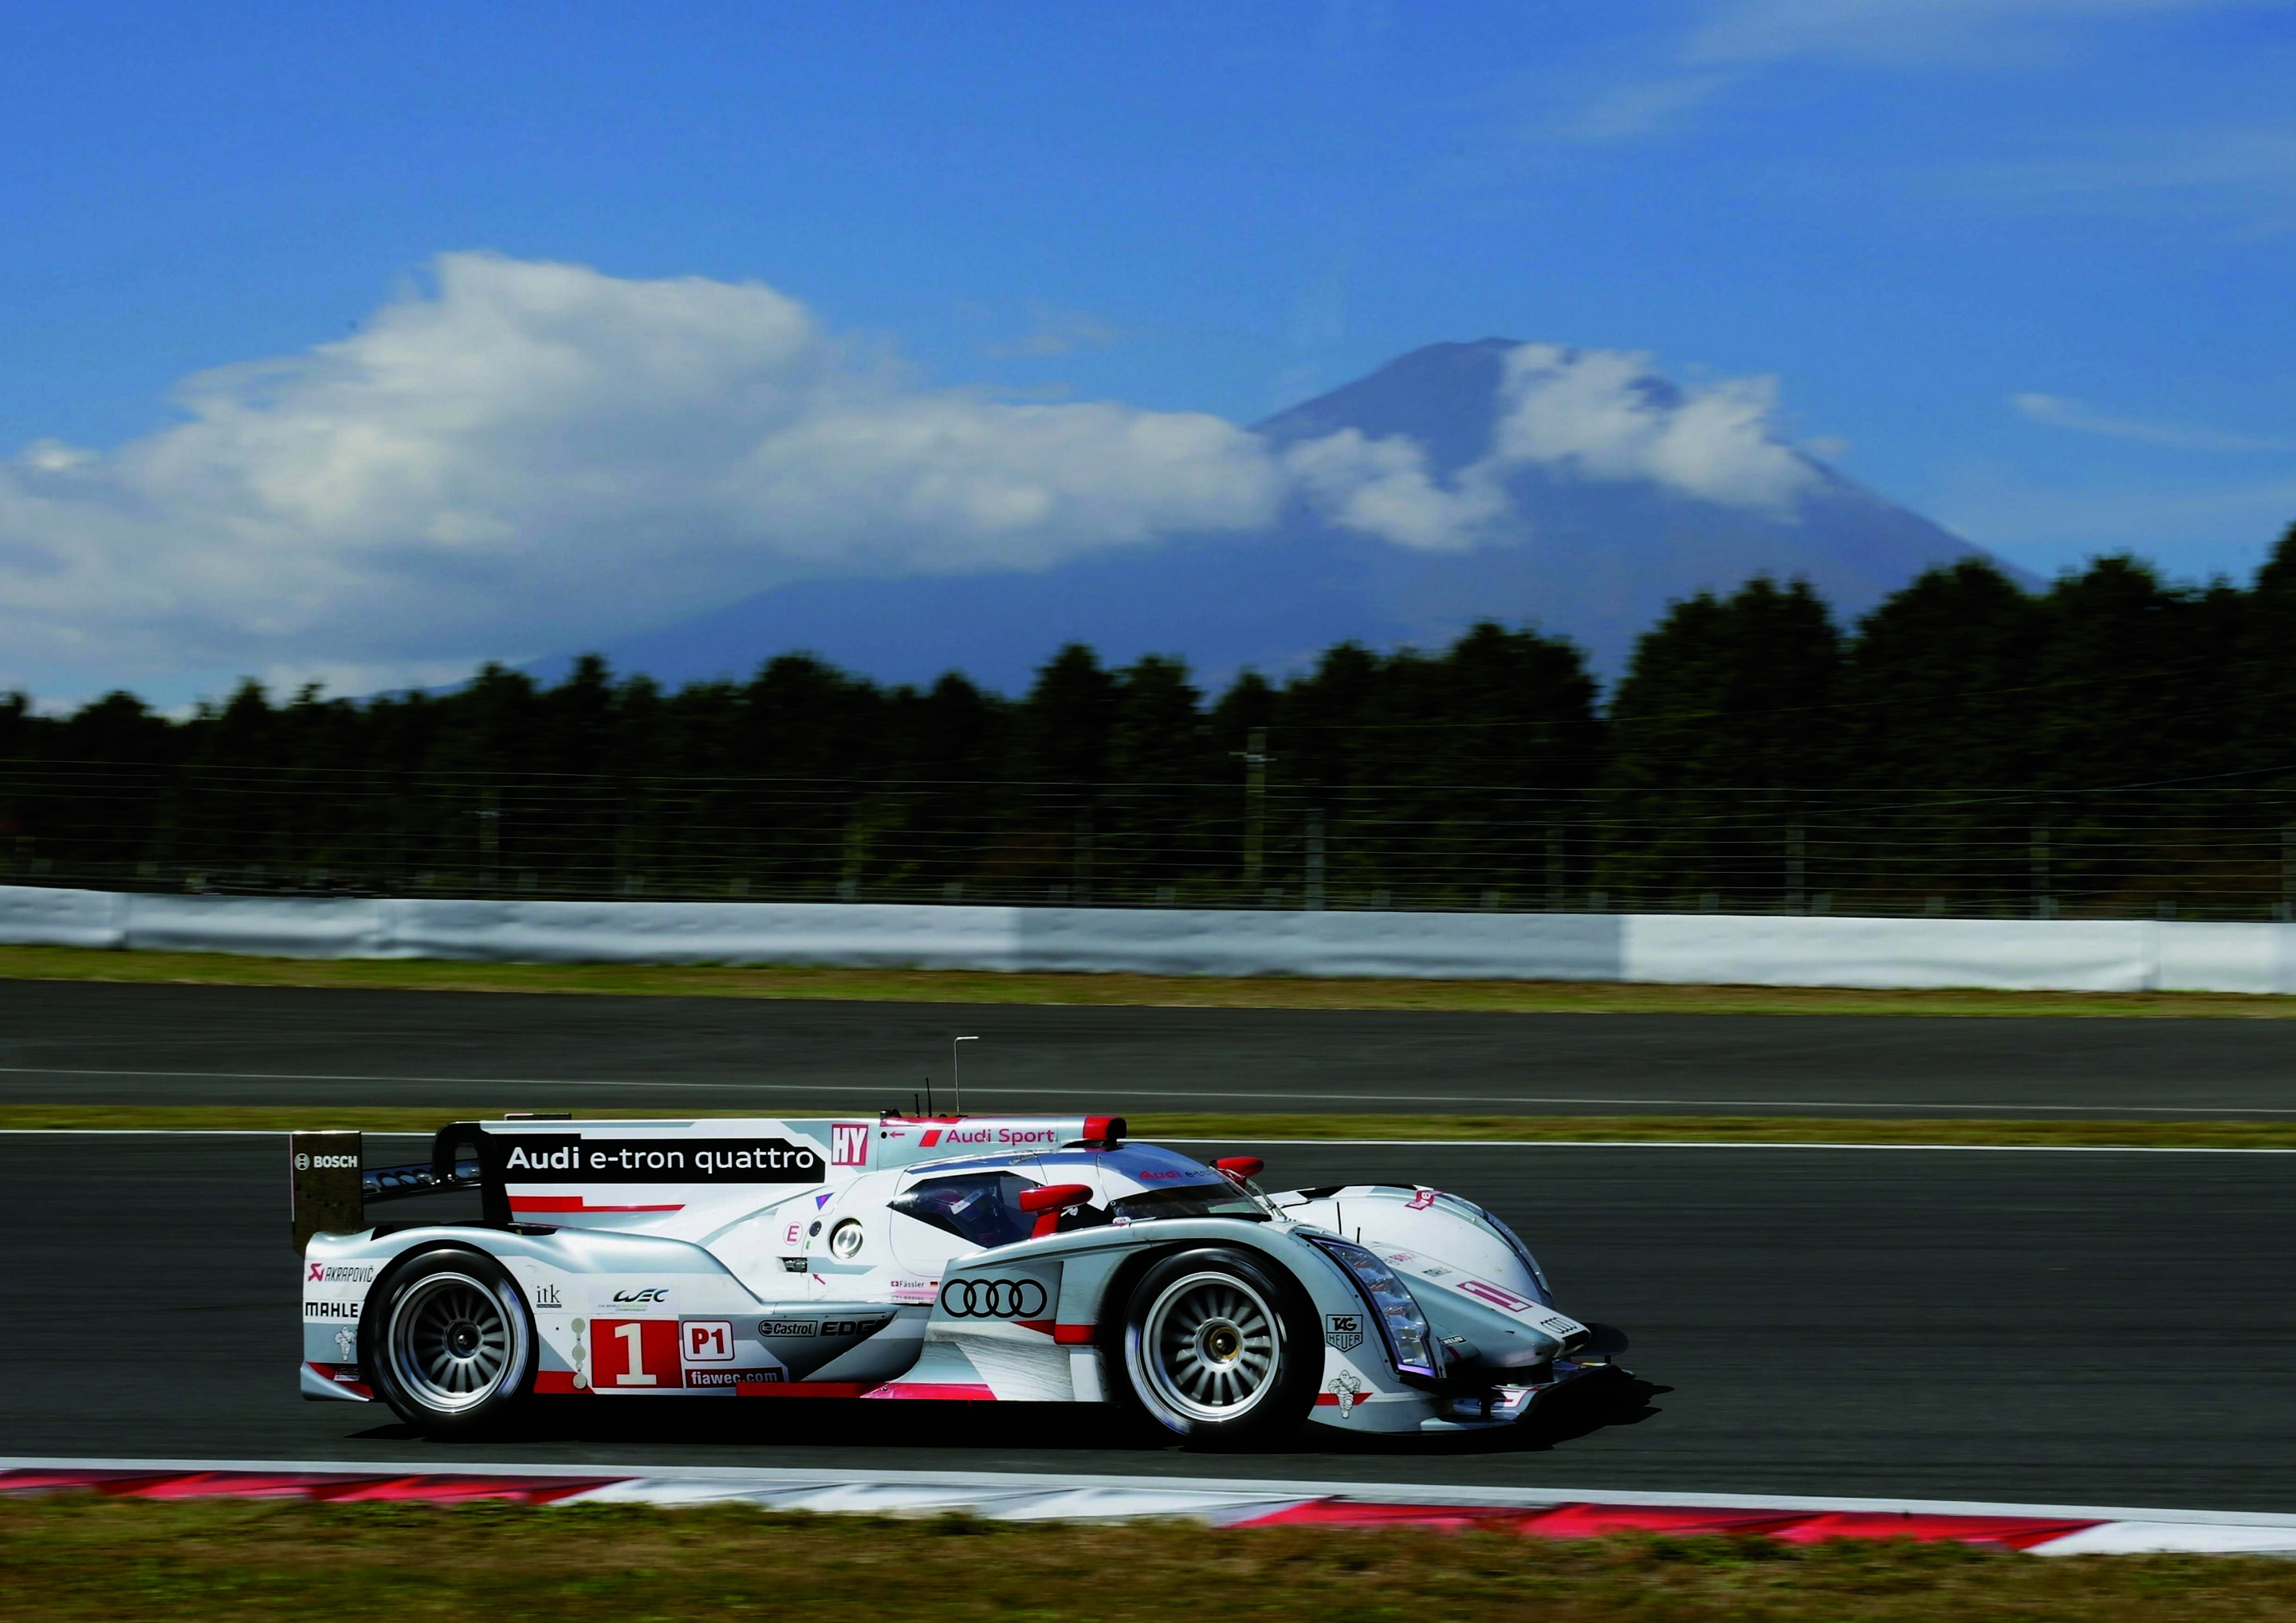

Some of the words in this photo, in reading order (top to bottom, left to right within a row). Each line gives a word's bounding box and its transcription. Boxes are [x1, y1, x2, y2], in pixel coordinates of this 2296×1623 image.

[946, 1128, 992, 1142] Audi
[998, 1128, 1056, 1146] Sport
[832, 1127, 867, 1164] HY
[313, 1155, 358, 1168] BOSCH
[506, 1146, 580, 1169] Audi
[589, 1148, 684, 1169] e-tron
[694, 1149, 815, 1174] quattro
[1140, 1170, 1181, 1180] Audi
[786, 1225, 800, 1242] E
[536, 1283, 561, 1303] itk
[613, 1288, 670, 1303] WEC
[305, 1302, 358, 1318] MAHLE
[773, 1322, 813, 1335] Castrol
[1332, 1317, 1357, 1331] TAG
[691, 1328, 725, 1354] P1
[1328, 1334, 1360, 1350] HEUER
[614, 1322, 657, 1385] 1
[690, 1371, 777, 1385] fiawec.com
